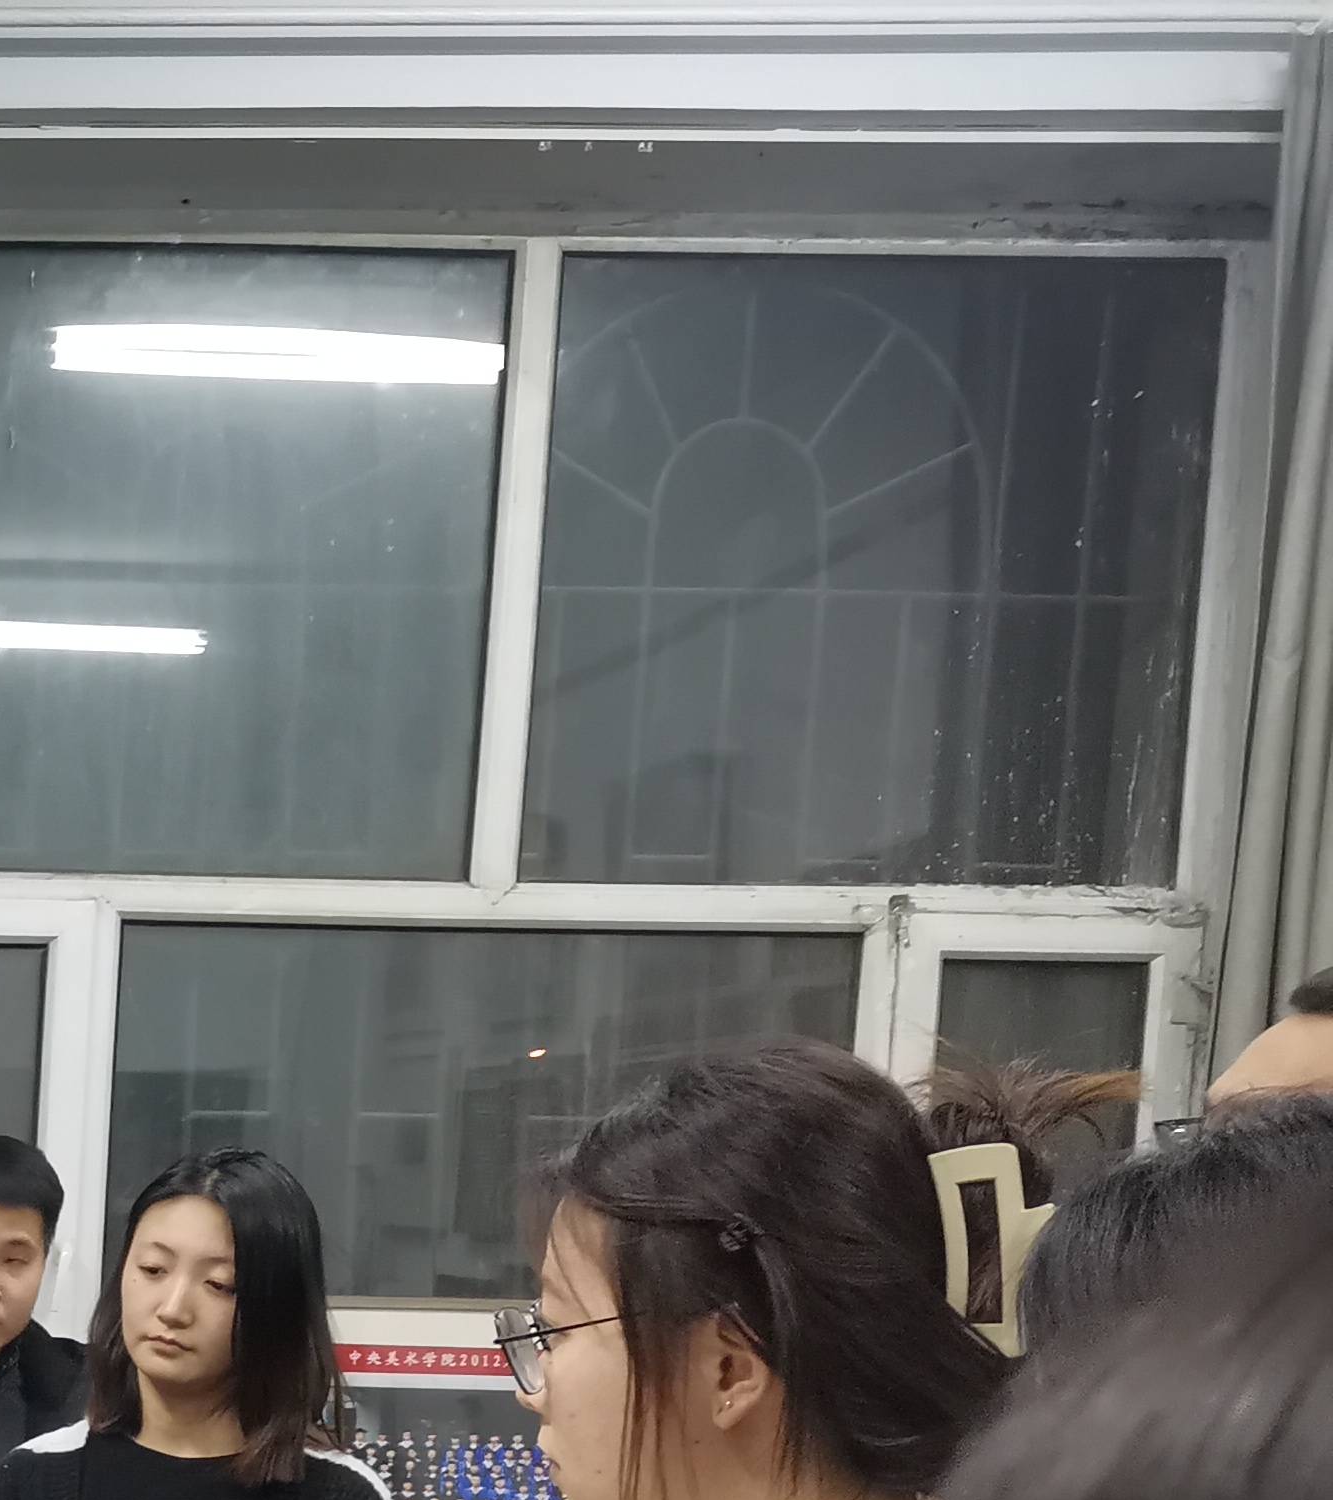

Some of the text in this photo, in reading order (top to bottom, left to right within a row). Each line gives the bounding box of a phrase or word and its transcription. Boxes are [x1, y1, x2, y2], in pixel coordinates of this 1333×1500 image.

[348, 1349, 510, 1368] 中央美术学院2012
